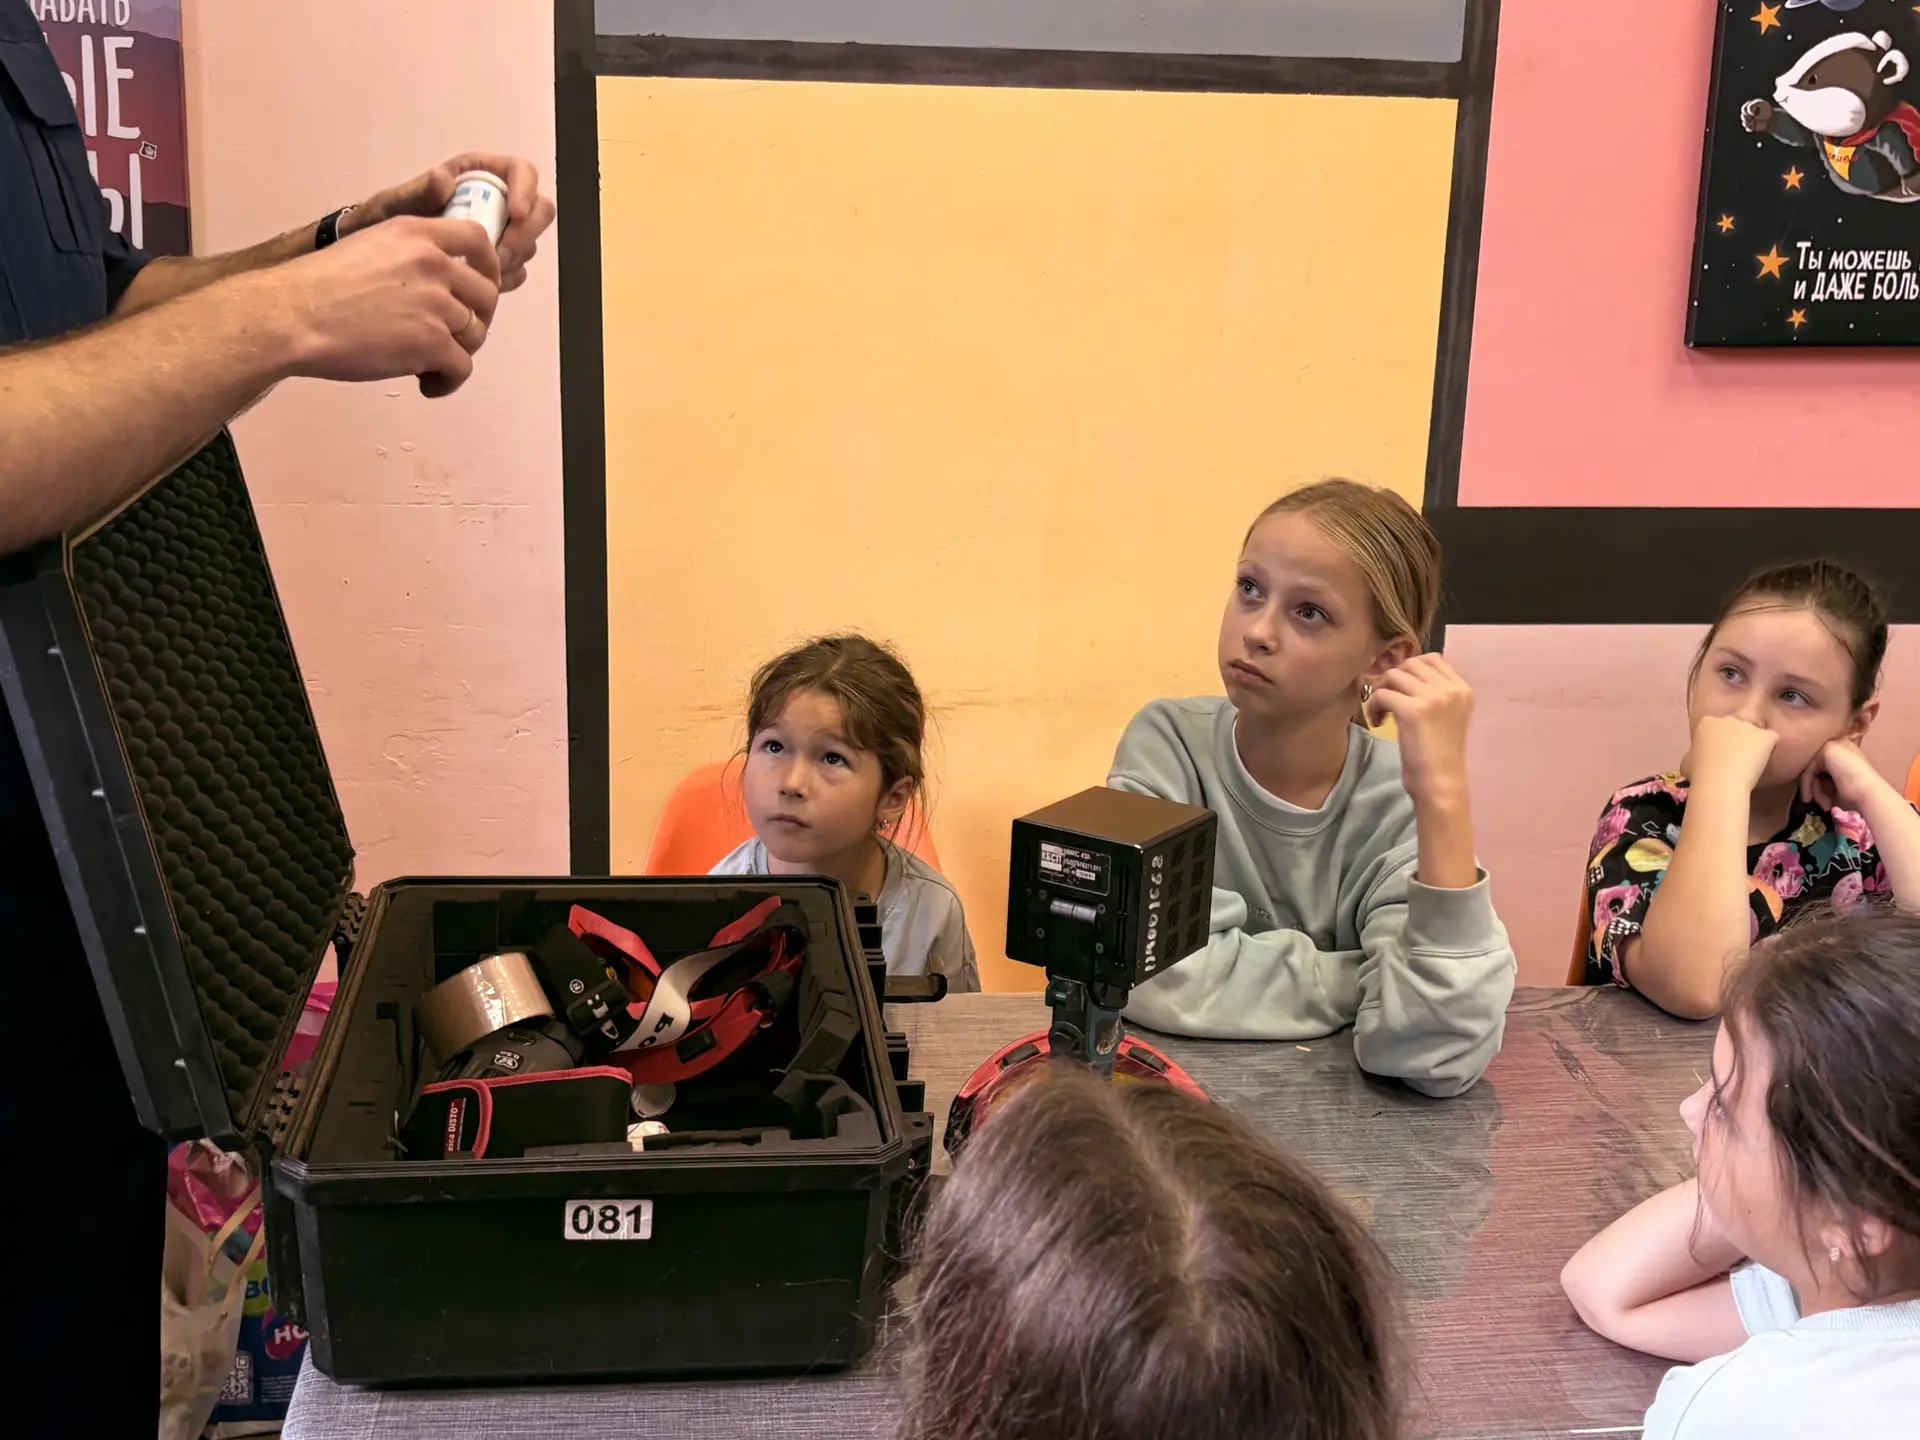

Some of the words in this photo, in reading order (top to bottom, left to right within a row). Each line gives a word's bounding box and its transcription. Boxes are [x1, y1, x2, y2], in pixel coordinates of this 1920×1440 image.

[1811, 272, 1868, 302] ДАЖЕ
[447, 1133, 456, 1152] eica
[572, 1204, 642, 1235] 081
